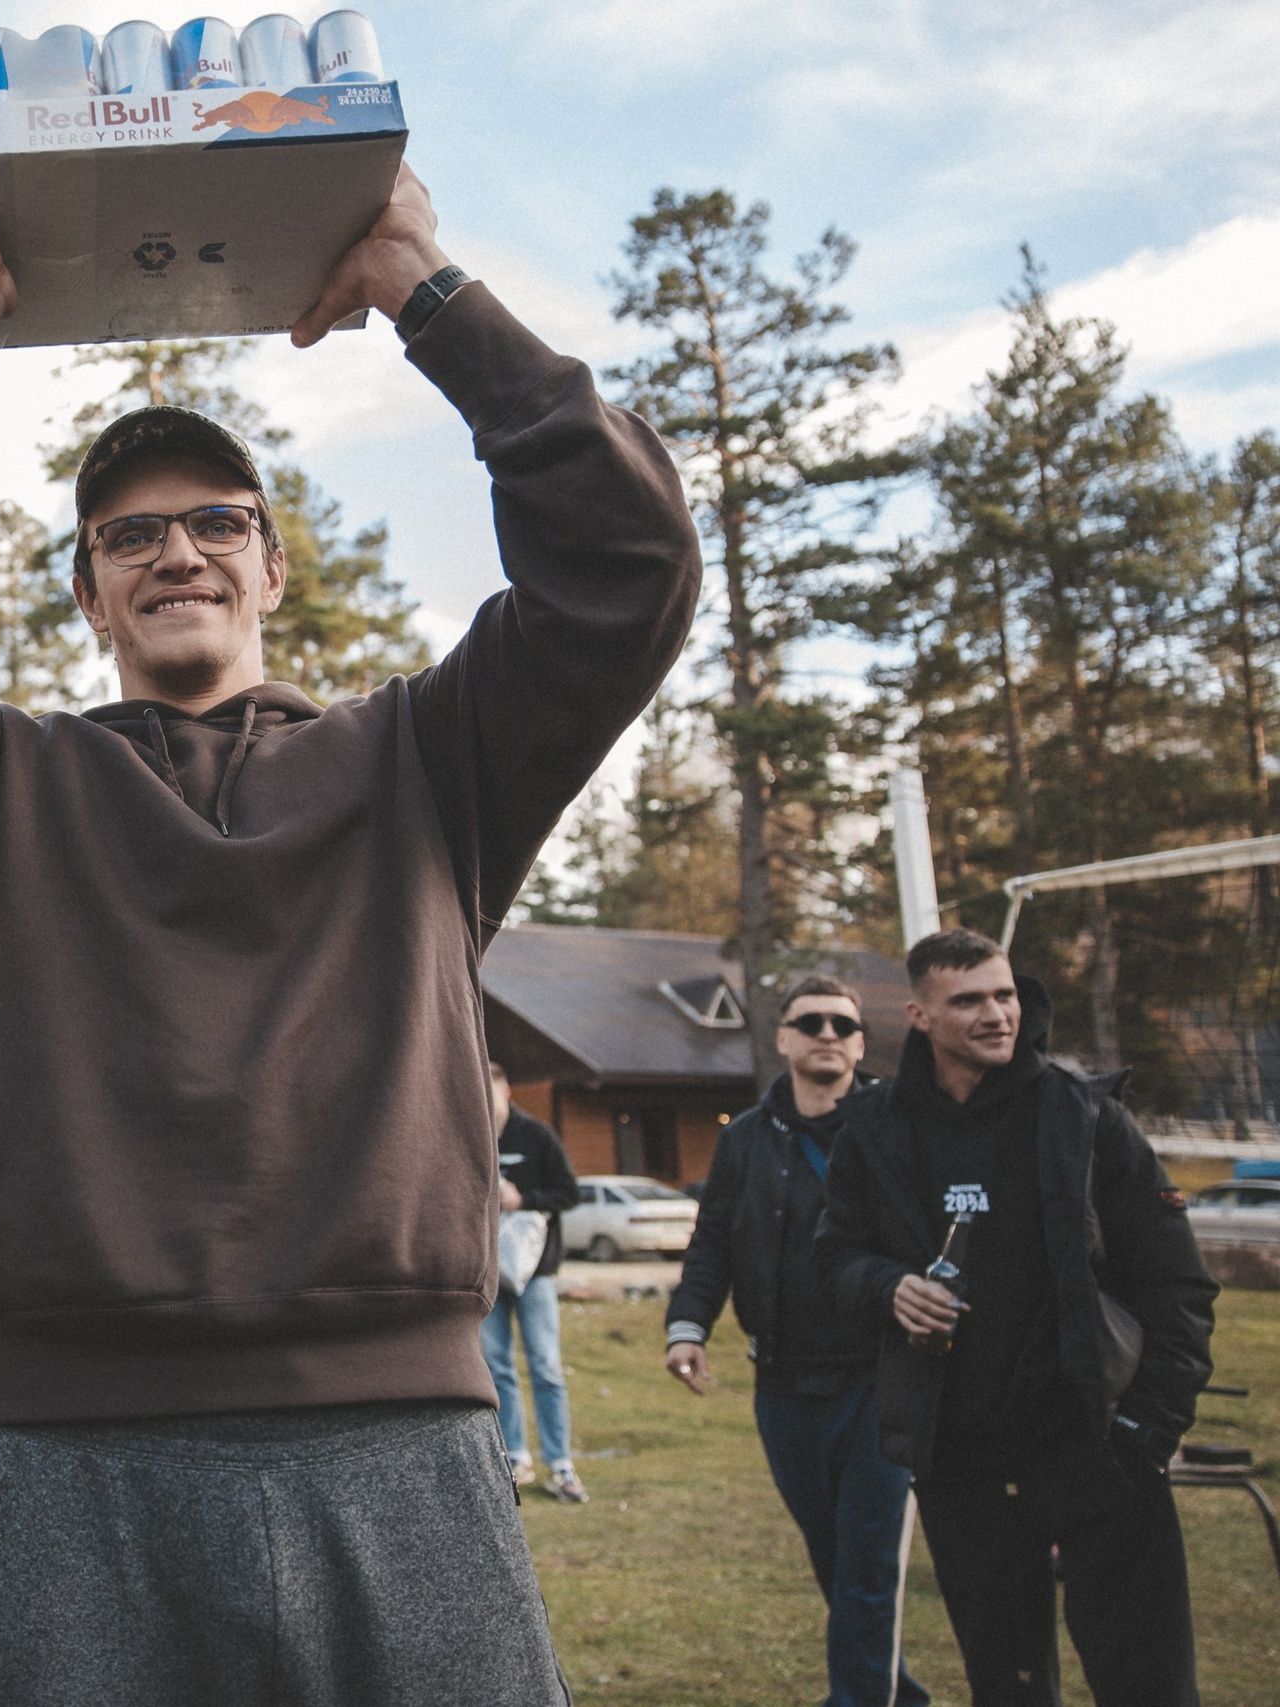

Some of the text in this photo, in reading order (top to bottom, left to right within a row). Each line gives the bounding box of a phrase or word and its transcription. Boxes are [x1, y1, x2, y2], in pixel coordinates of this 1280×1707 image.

[197, 58, 232, 74] Bull
[26, 96, 171, 130] Red Bull
[28, 127, 174, 146] ENERGY DRINK
